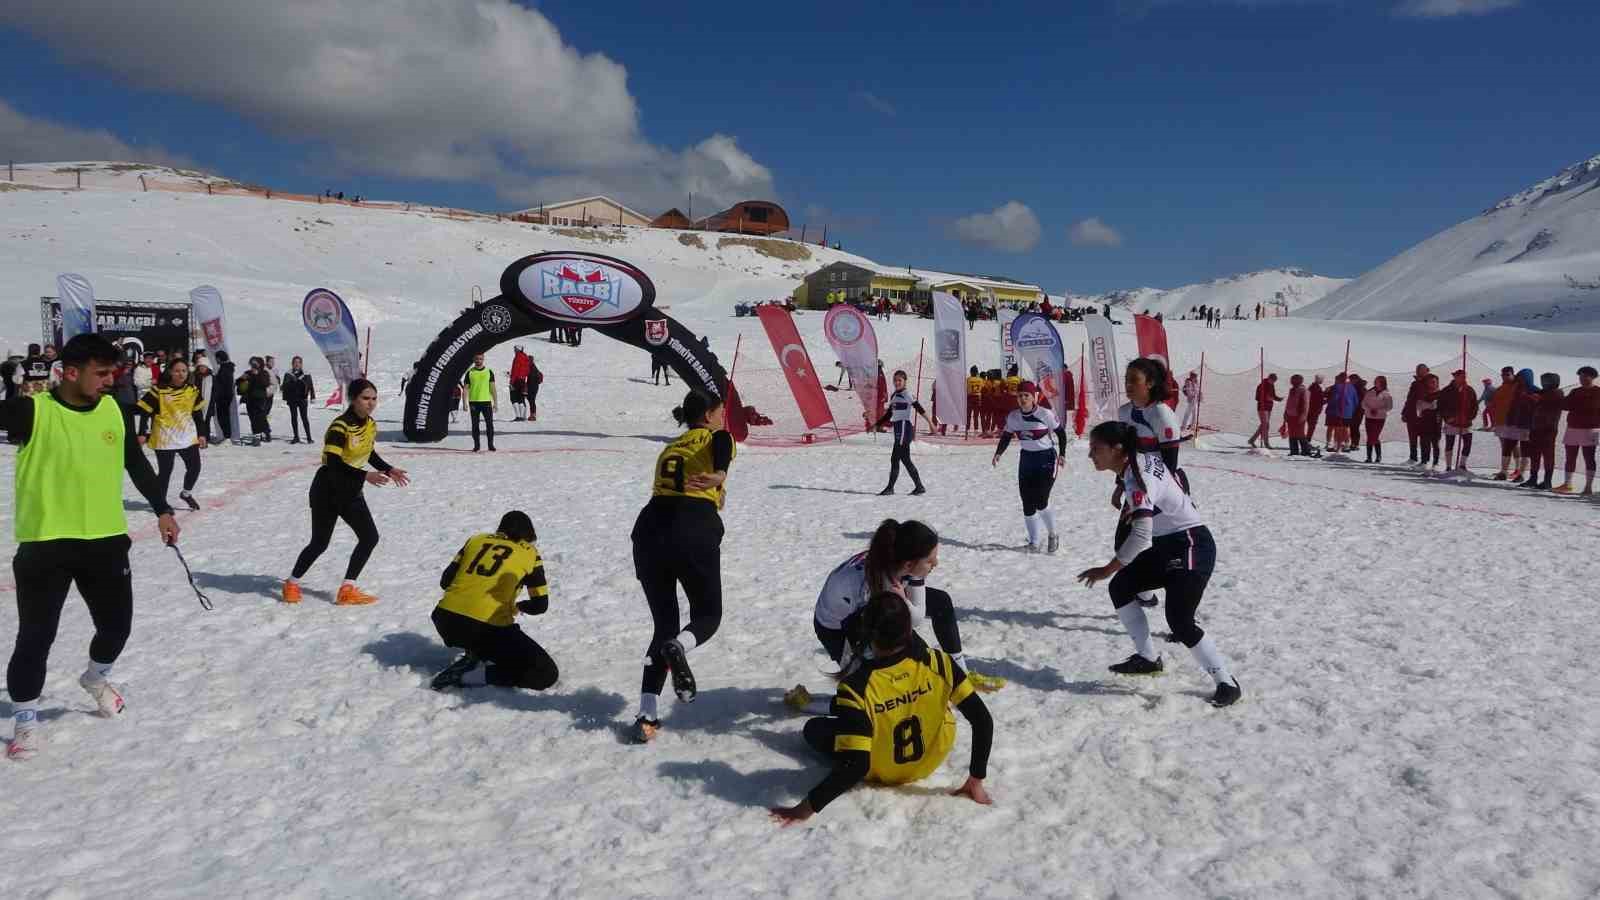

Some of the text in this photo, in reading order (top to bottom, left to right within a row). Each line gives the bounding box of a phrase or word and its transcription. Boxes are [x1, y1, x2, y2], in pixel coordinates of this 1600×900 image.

[436, 322, 484, 370] FEDERASYONU
[661, 453, 684, 492] 9
[466, 543, 513, 577] 13
[893, 715, 925, 764] 8
